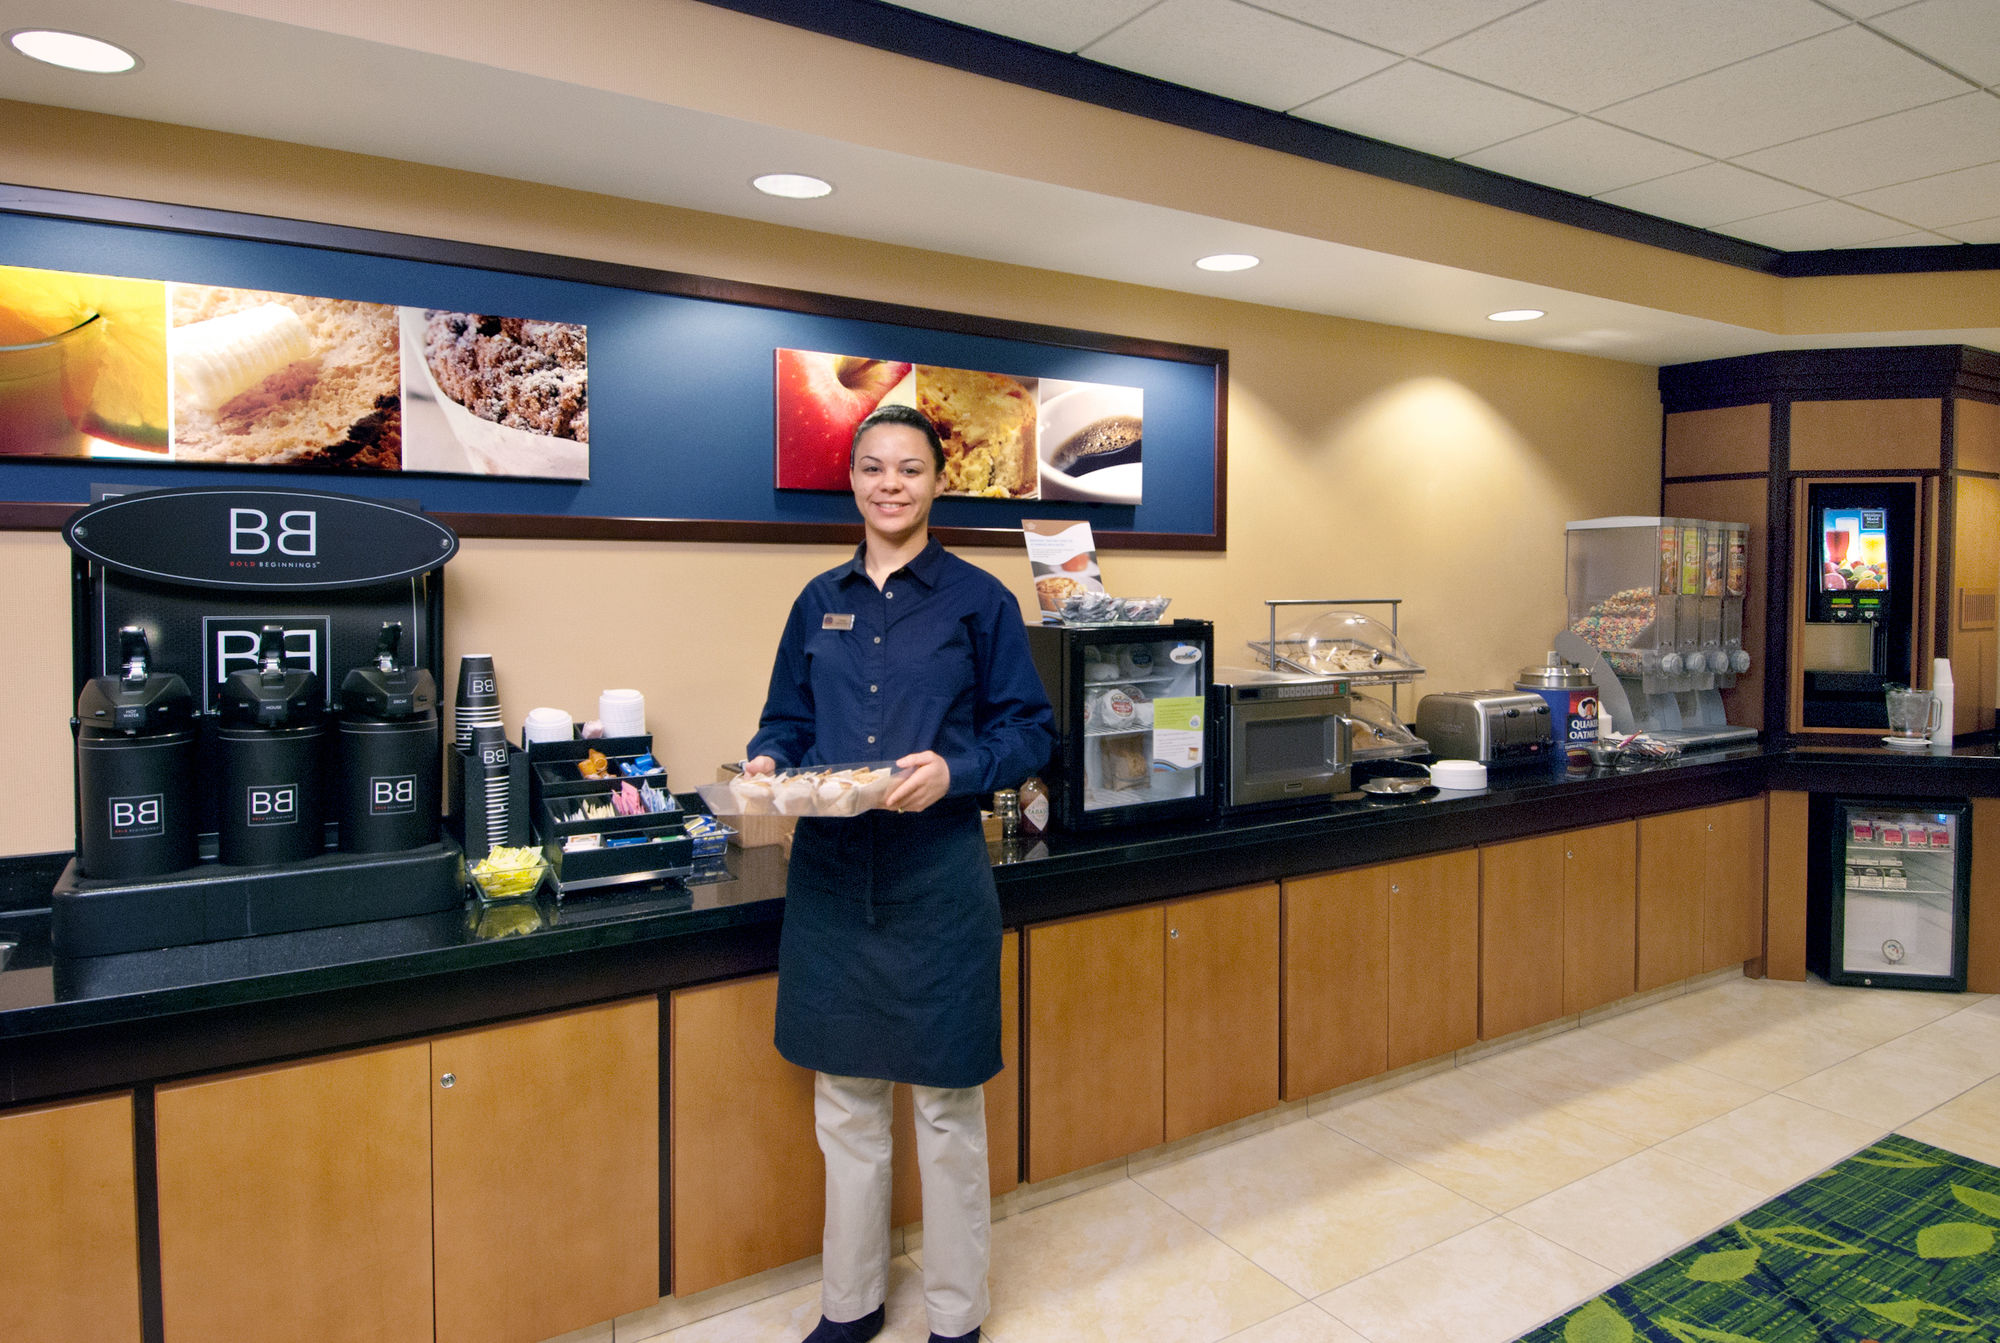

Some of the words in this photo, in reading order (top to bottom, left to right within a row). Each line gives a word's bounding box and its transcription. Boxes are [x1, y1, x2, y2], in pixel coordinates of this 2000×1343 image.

[230, 508, 317, 556] BB
[252, 790, 293, 814] BB
[375, 780, 412, 803] BB
[114, 800, 159, 827] BB
